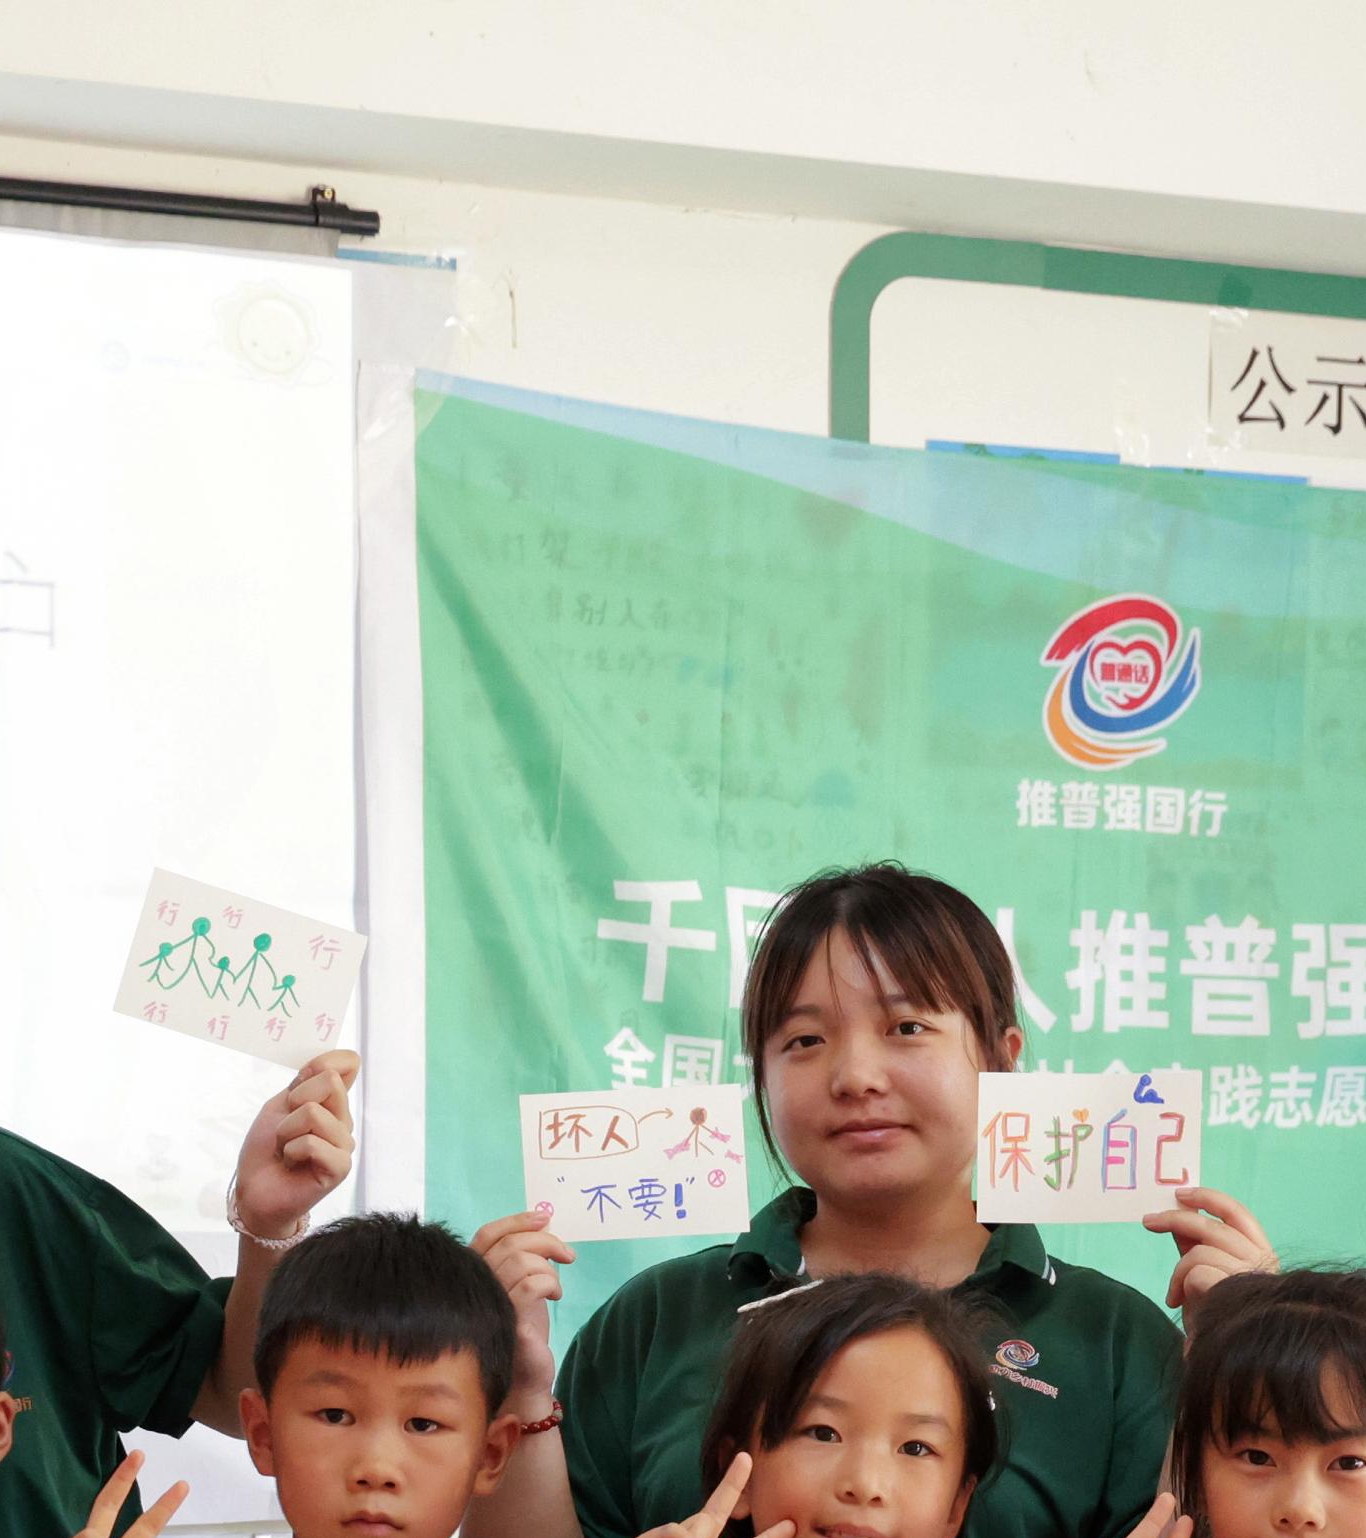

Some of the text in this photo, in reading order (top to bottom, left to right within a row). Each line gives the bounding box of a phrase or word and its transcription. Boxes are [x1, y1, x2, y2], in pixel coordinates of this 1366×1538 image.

[1015, 778, 1228, 838] 推普强国行
[546, 1112, 629, 1153] 坏人
[983, 1109, 1190, 1193] 保护自己
